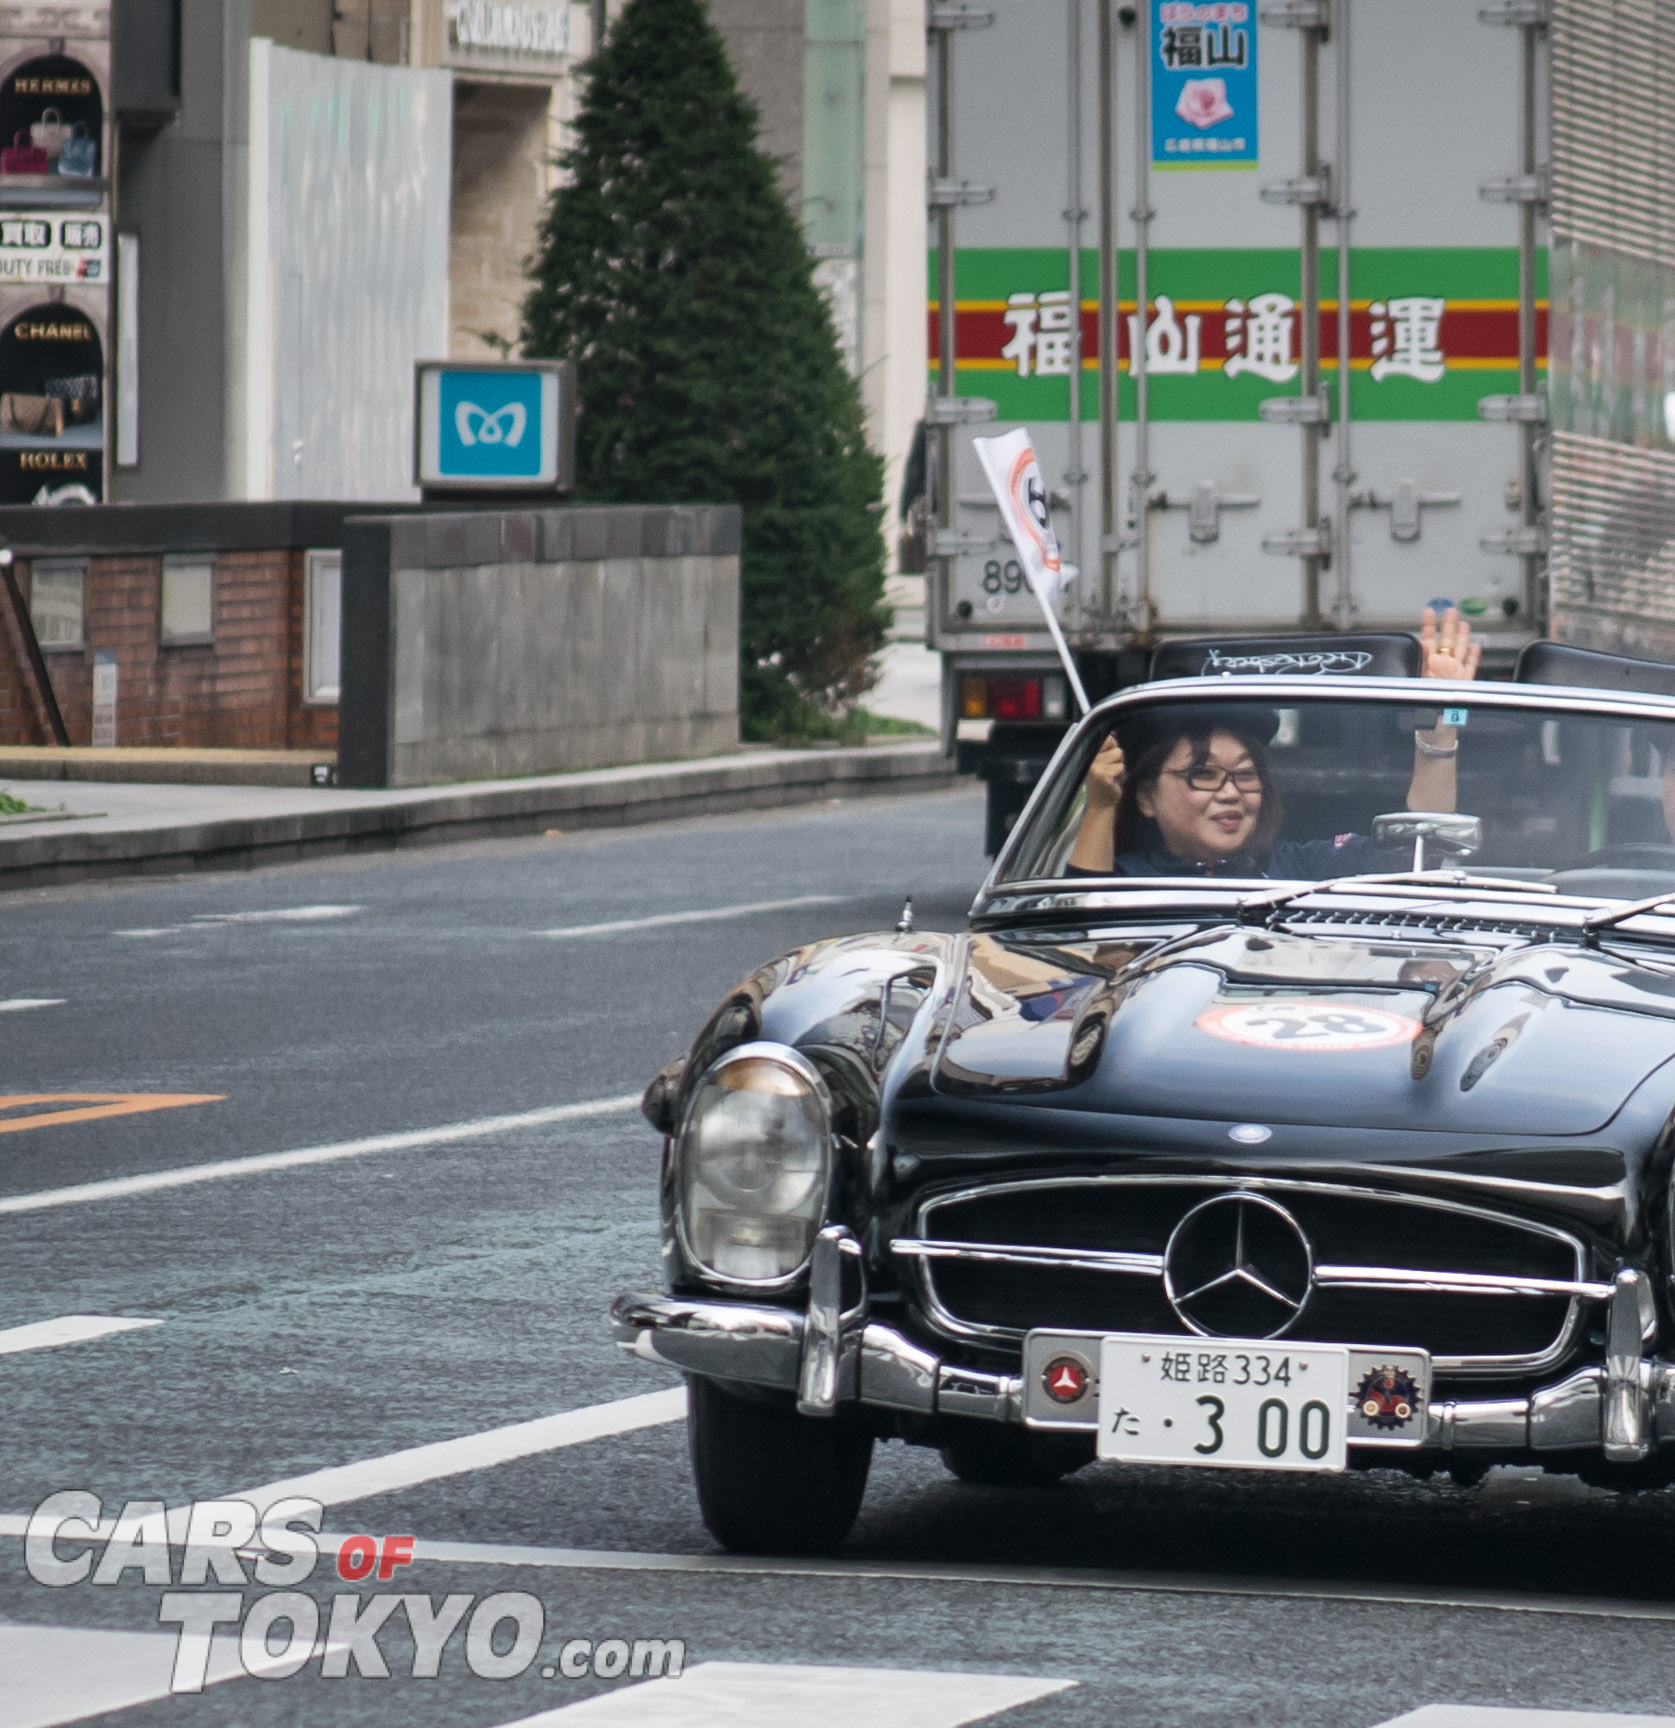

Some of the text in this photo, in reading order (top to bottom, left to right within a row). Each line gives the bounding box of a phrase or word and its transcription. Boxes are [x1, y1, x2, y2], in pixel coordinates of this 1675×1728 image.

[1162, 25, 1245, 67] 福山
[0, 259, 70, 275] UTY FREE
[15, 323, 90, 339] CHANEL
[1002, 290, 1446, 383] 福山通運
[1244, 1014, 1388, 1040] 28
[1111, 1406, 1140, 1436] た
